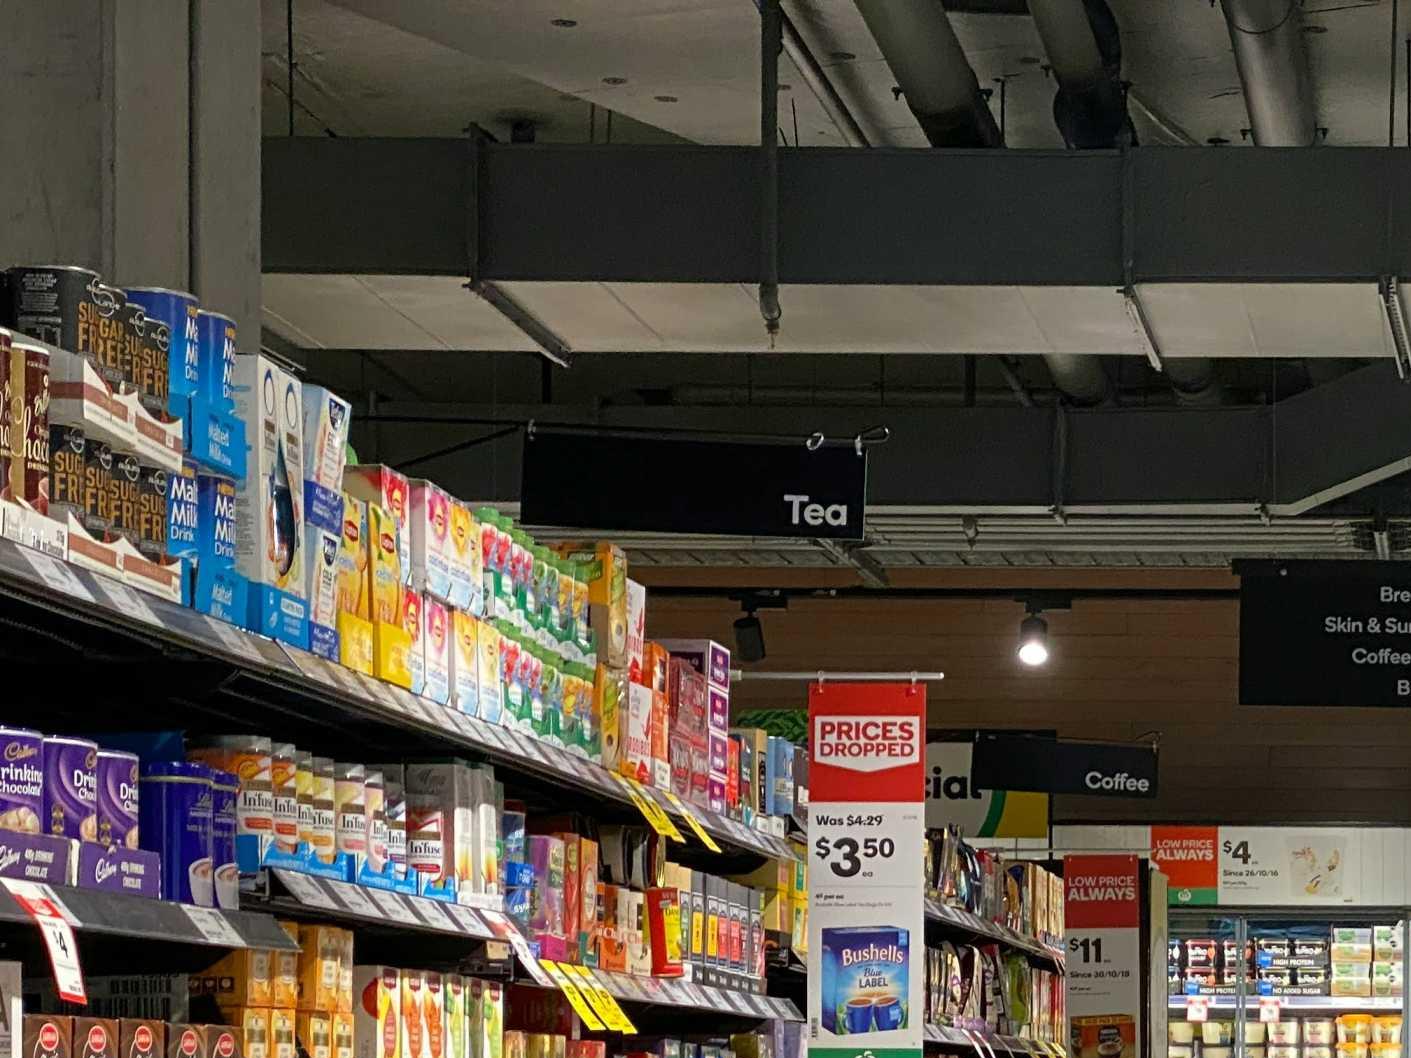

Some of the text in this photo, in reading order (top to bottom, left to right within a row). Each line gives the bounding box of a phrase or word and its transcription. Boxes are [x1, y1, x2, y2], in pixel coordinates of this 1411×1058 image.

[55, 451, 84, 477] SUG
[784, 494, 848, 527] Tea
[1324, 616, 1363, 634] Skin
[1367, 618, 1381, 633] &
[1351, 648, 1411, 665] Coffee
[820, 721, 914, 742] PRICES
[820, 743, 914, 758] DROPPED
[0, 763, 42, 784] rinking
[1085, 771, 1150, 792] Coffee
[816, 815, 883, 826] Was $4.29
[1157, 839, 1214, 849] LOW PRICE
[1223, 840, 1251, 865] $4
[1154, 849, 1214, 861] ALWAYS
[1223, 869, 1244, 877] Since
[1068, 876, 1135, 888] LOW PRICE
[1068, 887, 1136, 902] ALWAYS
[842, 944, 904, 967] Bushells
[1069, 938, 1102, 963] $11
[864, 967, 882, 978] Blue
[859, 977, 889, 989] LABEL
